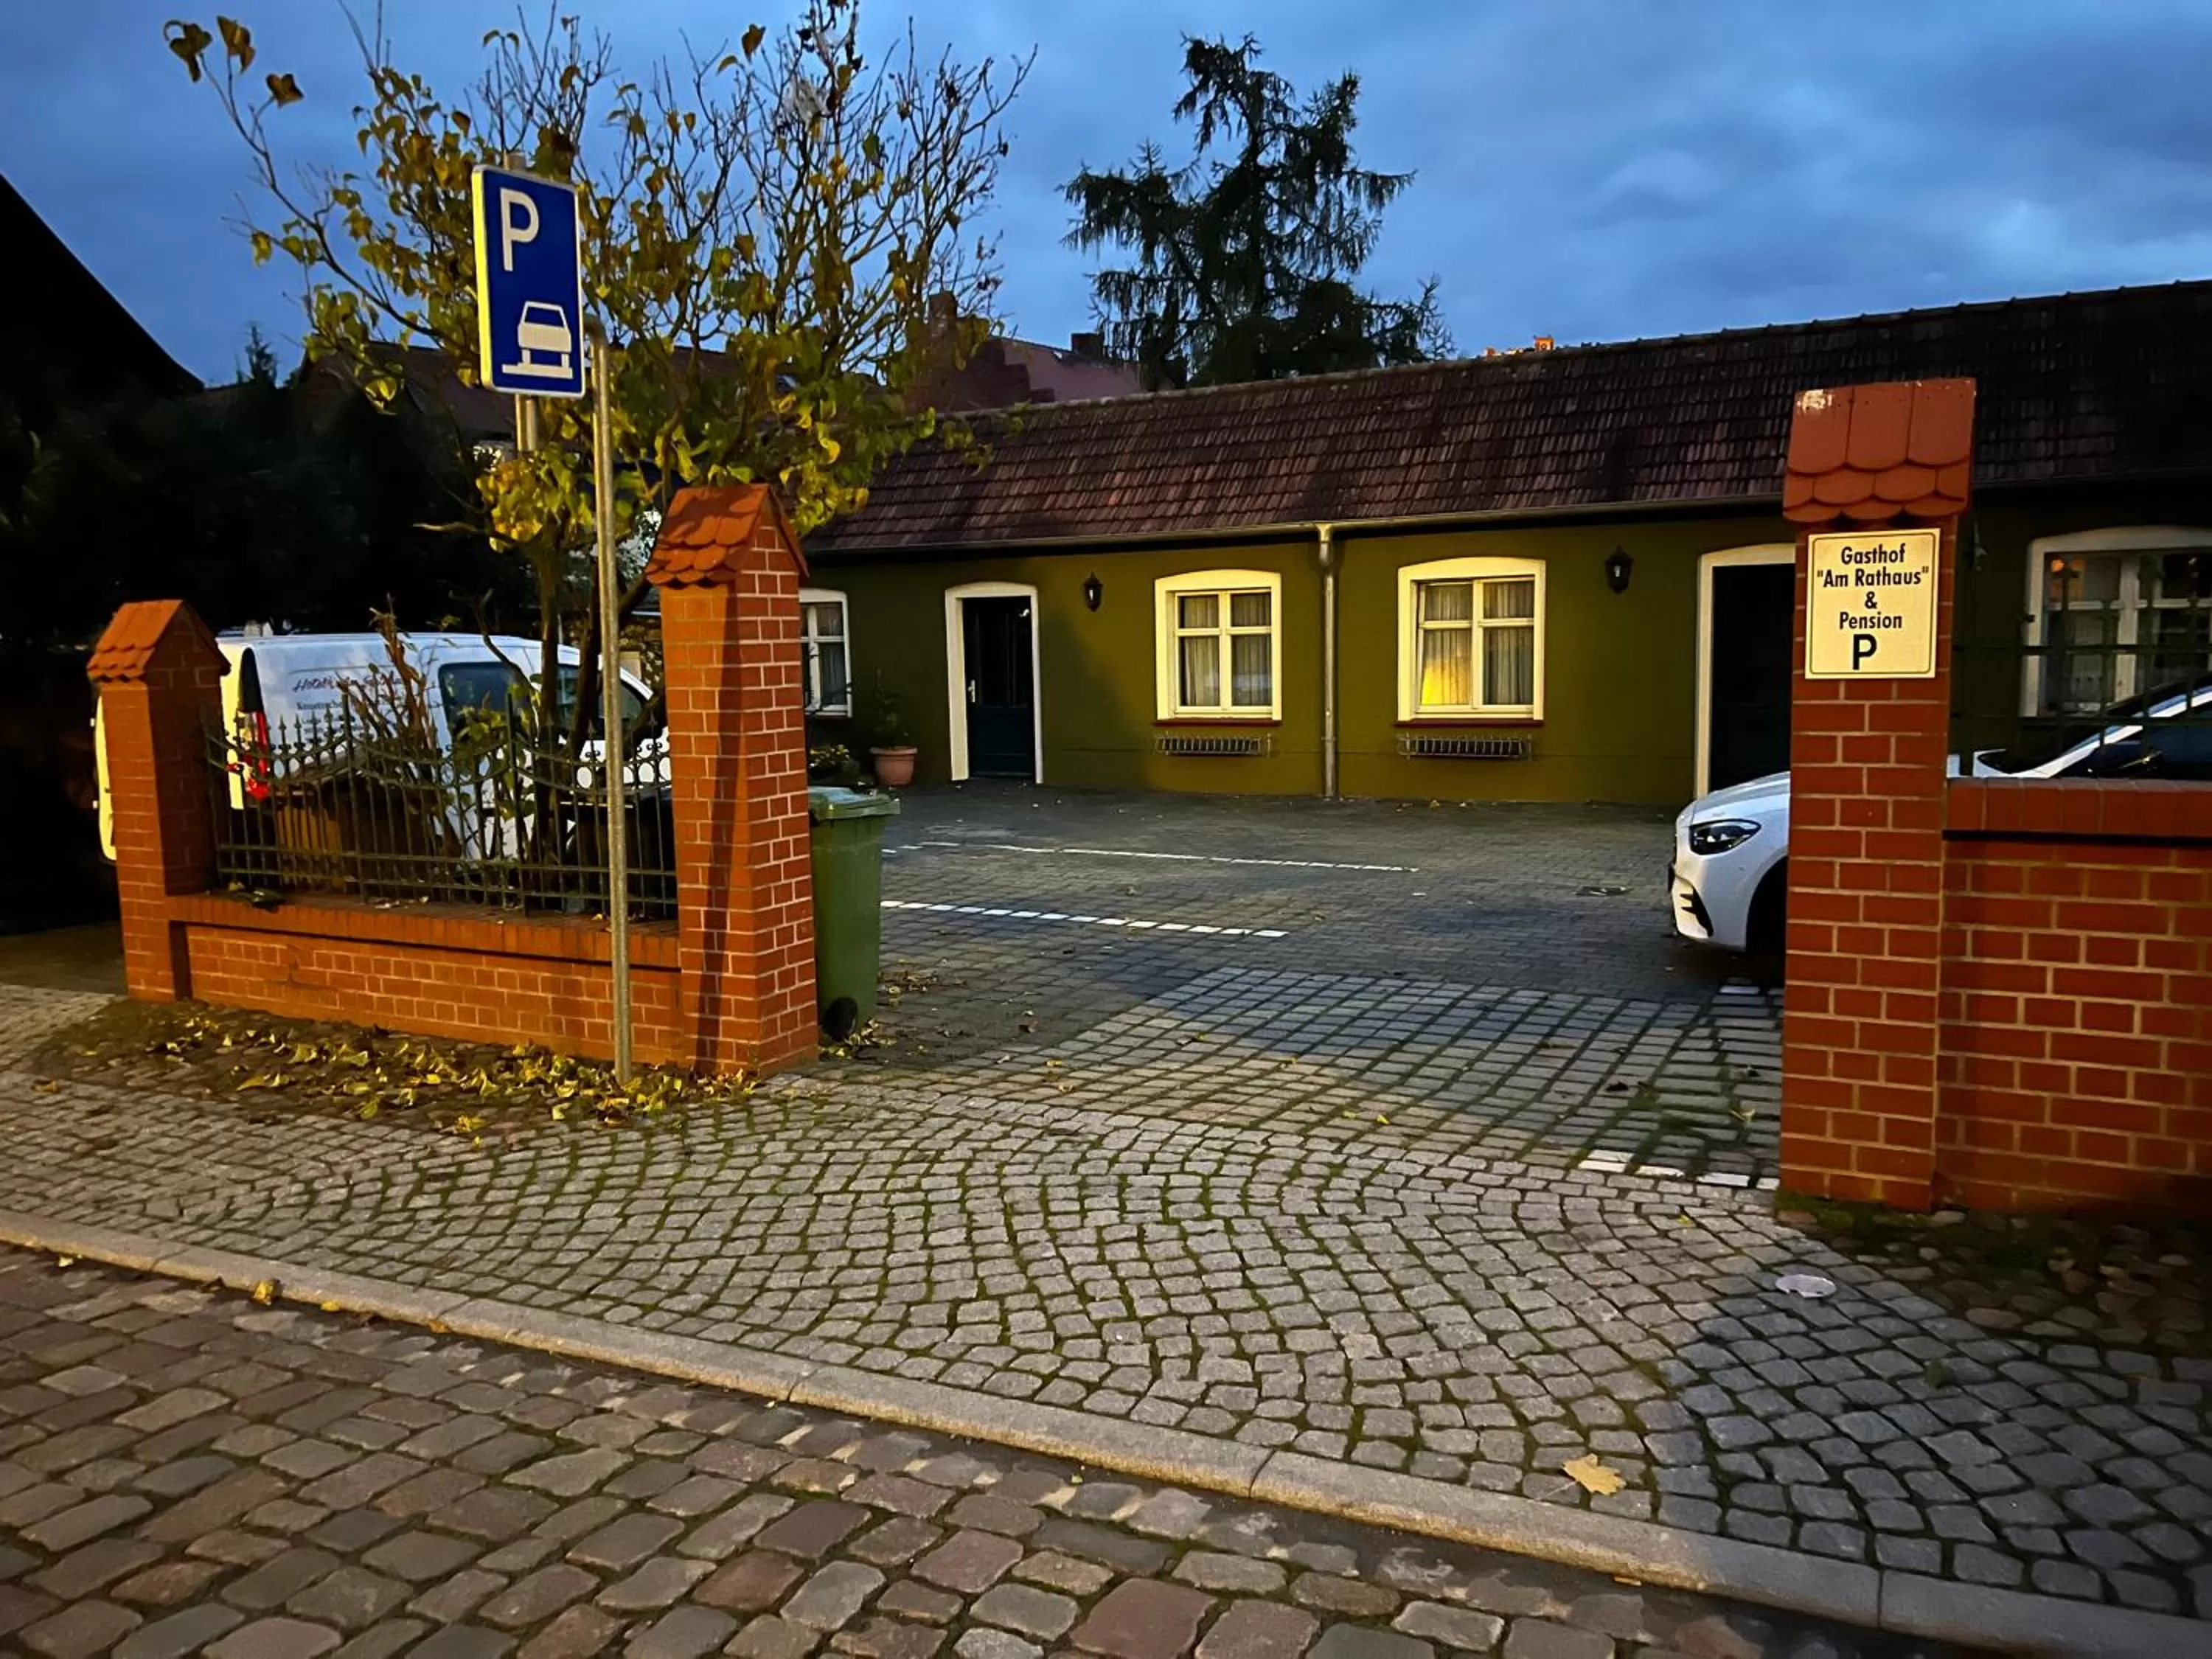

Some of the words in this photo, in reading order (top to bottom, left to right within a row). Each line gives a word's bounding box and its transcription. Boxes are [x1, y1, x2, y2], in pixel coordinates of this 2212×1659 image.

[500, 187, 539, 271] P
[1841, 543, 1906, 564] Gasthof
[1817, 569, 1848, 588] "Am
[1855, 566, 1929, 587] Rathaus"
[1864, 591, 1877, 609] &
[1840, 612, 1902, 629] Pension
[1852, 633, 1877, 670] P
